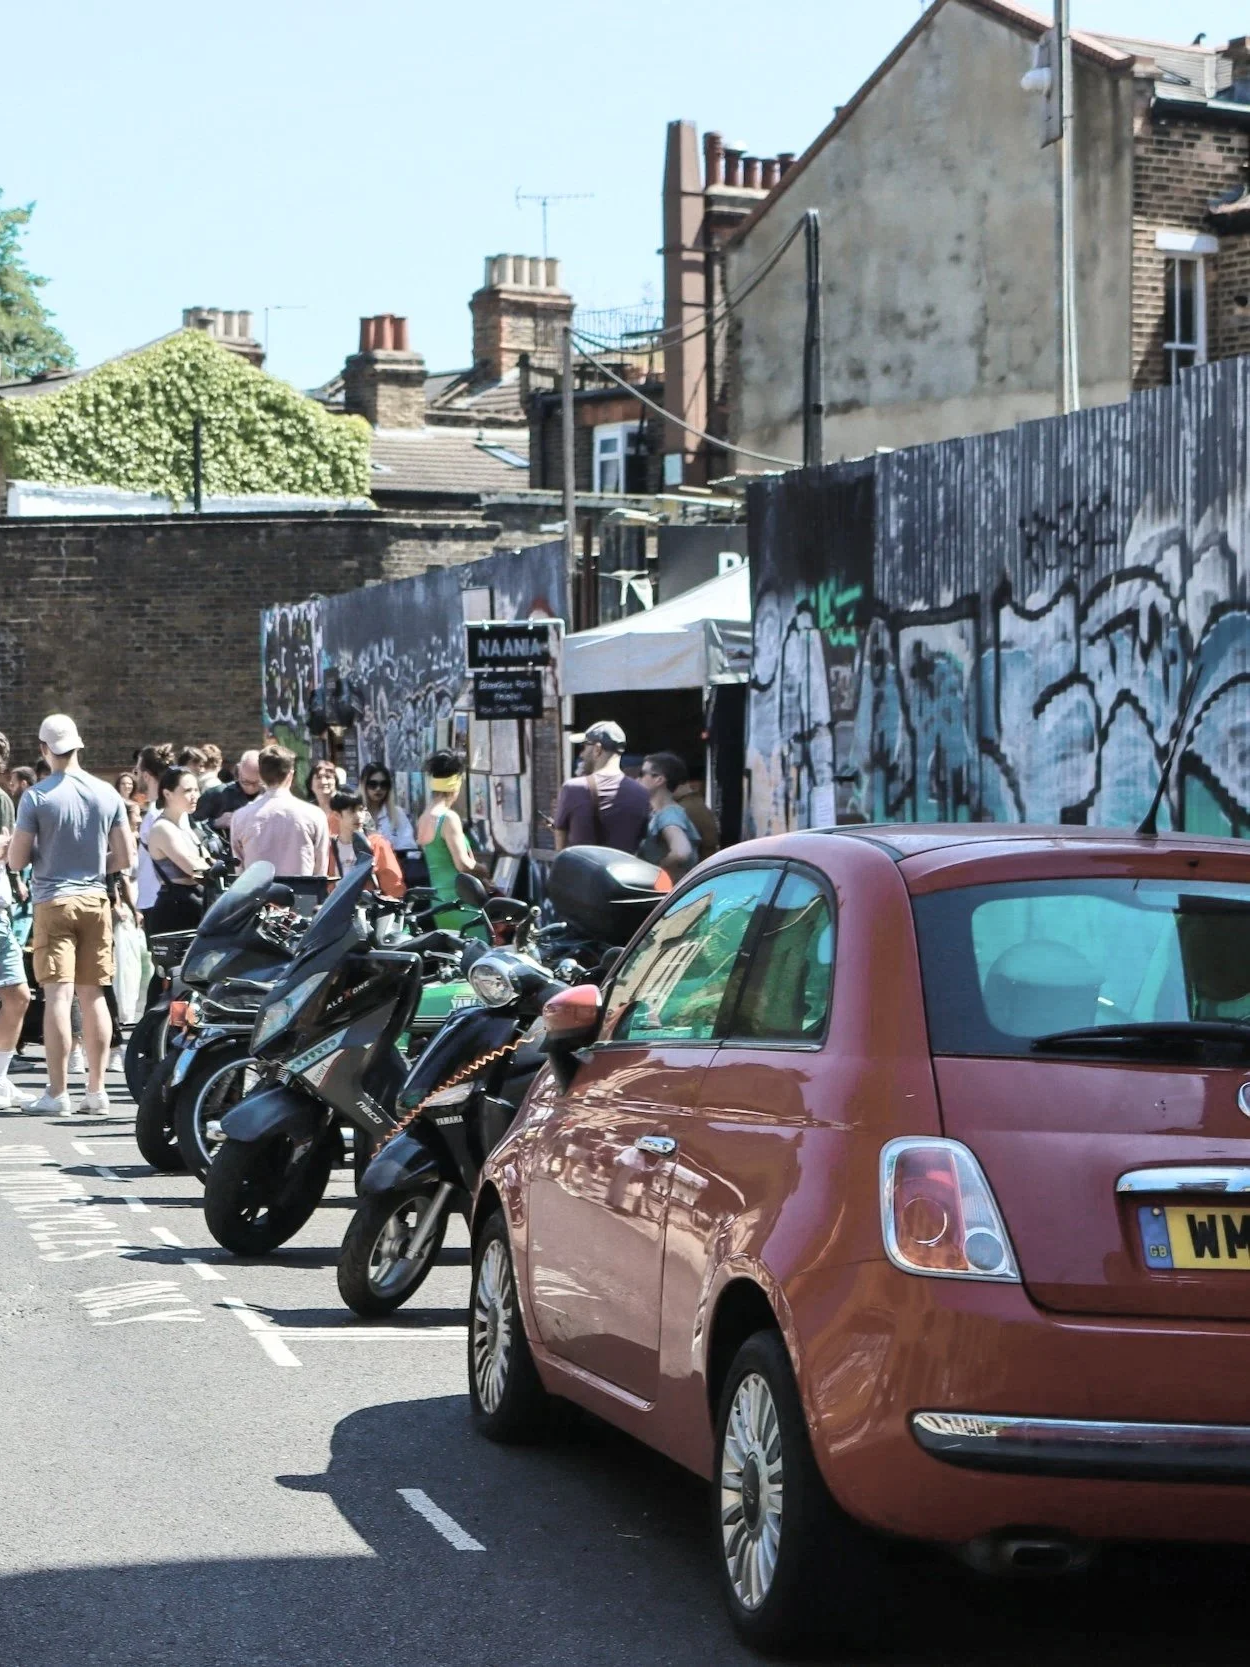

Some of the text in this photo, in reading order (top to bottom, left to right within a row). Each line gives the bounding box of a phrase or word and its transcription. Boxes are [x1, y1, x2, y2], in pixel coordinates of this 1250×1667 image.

[478, 638, 542, 657] NAANIA
[355, 1101, 384, 1124] neco
[435, 1115, 464, 1126] YAMAHA
[1150, 1245, 1167, 1257] GB
[74, 1280, 206, 1327] ONLY
